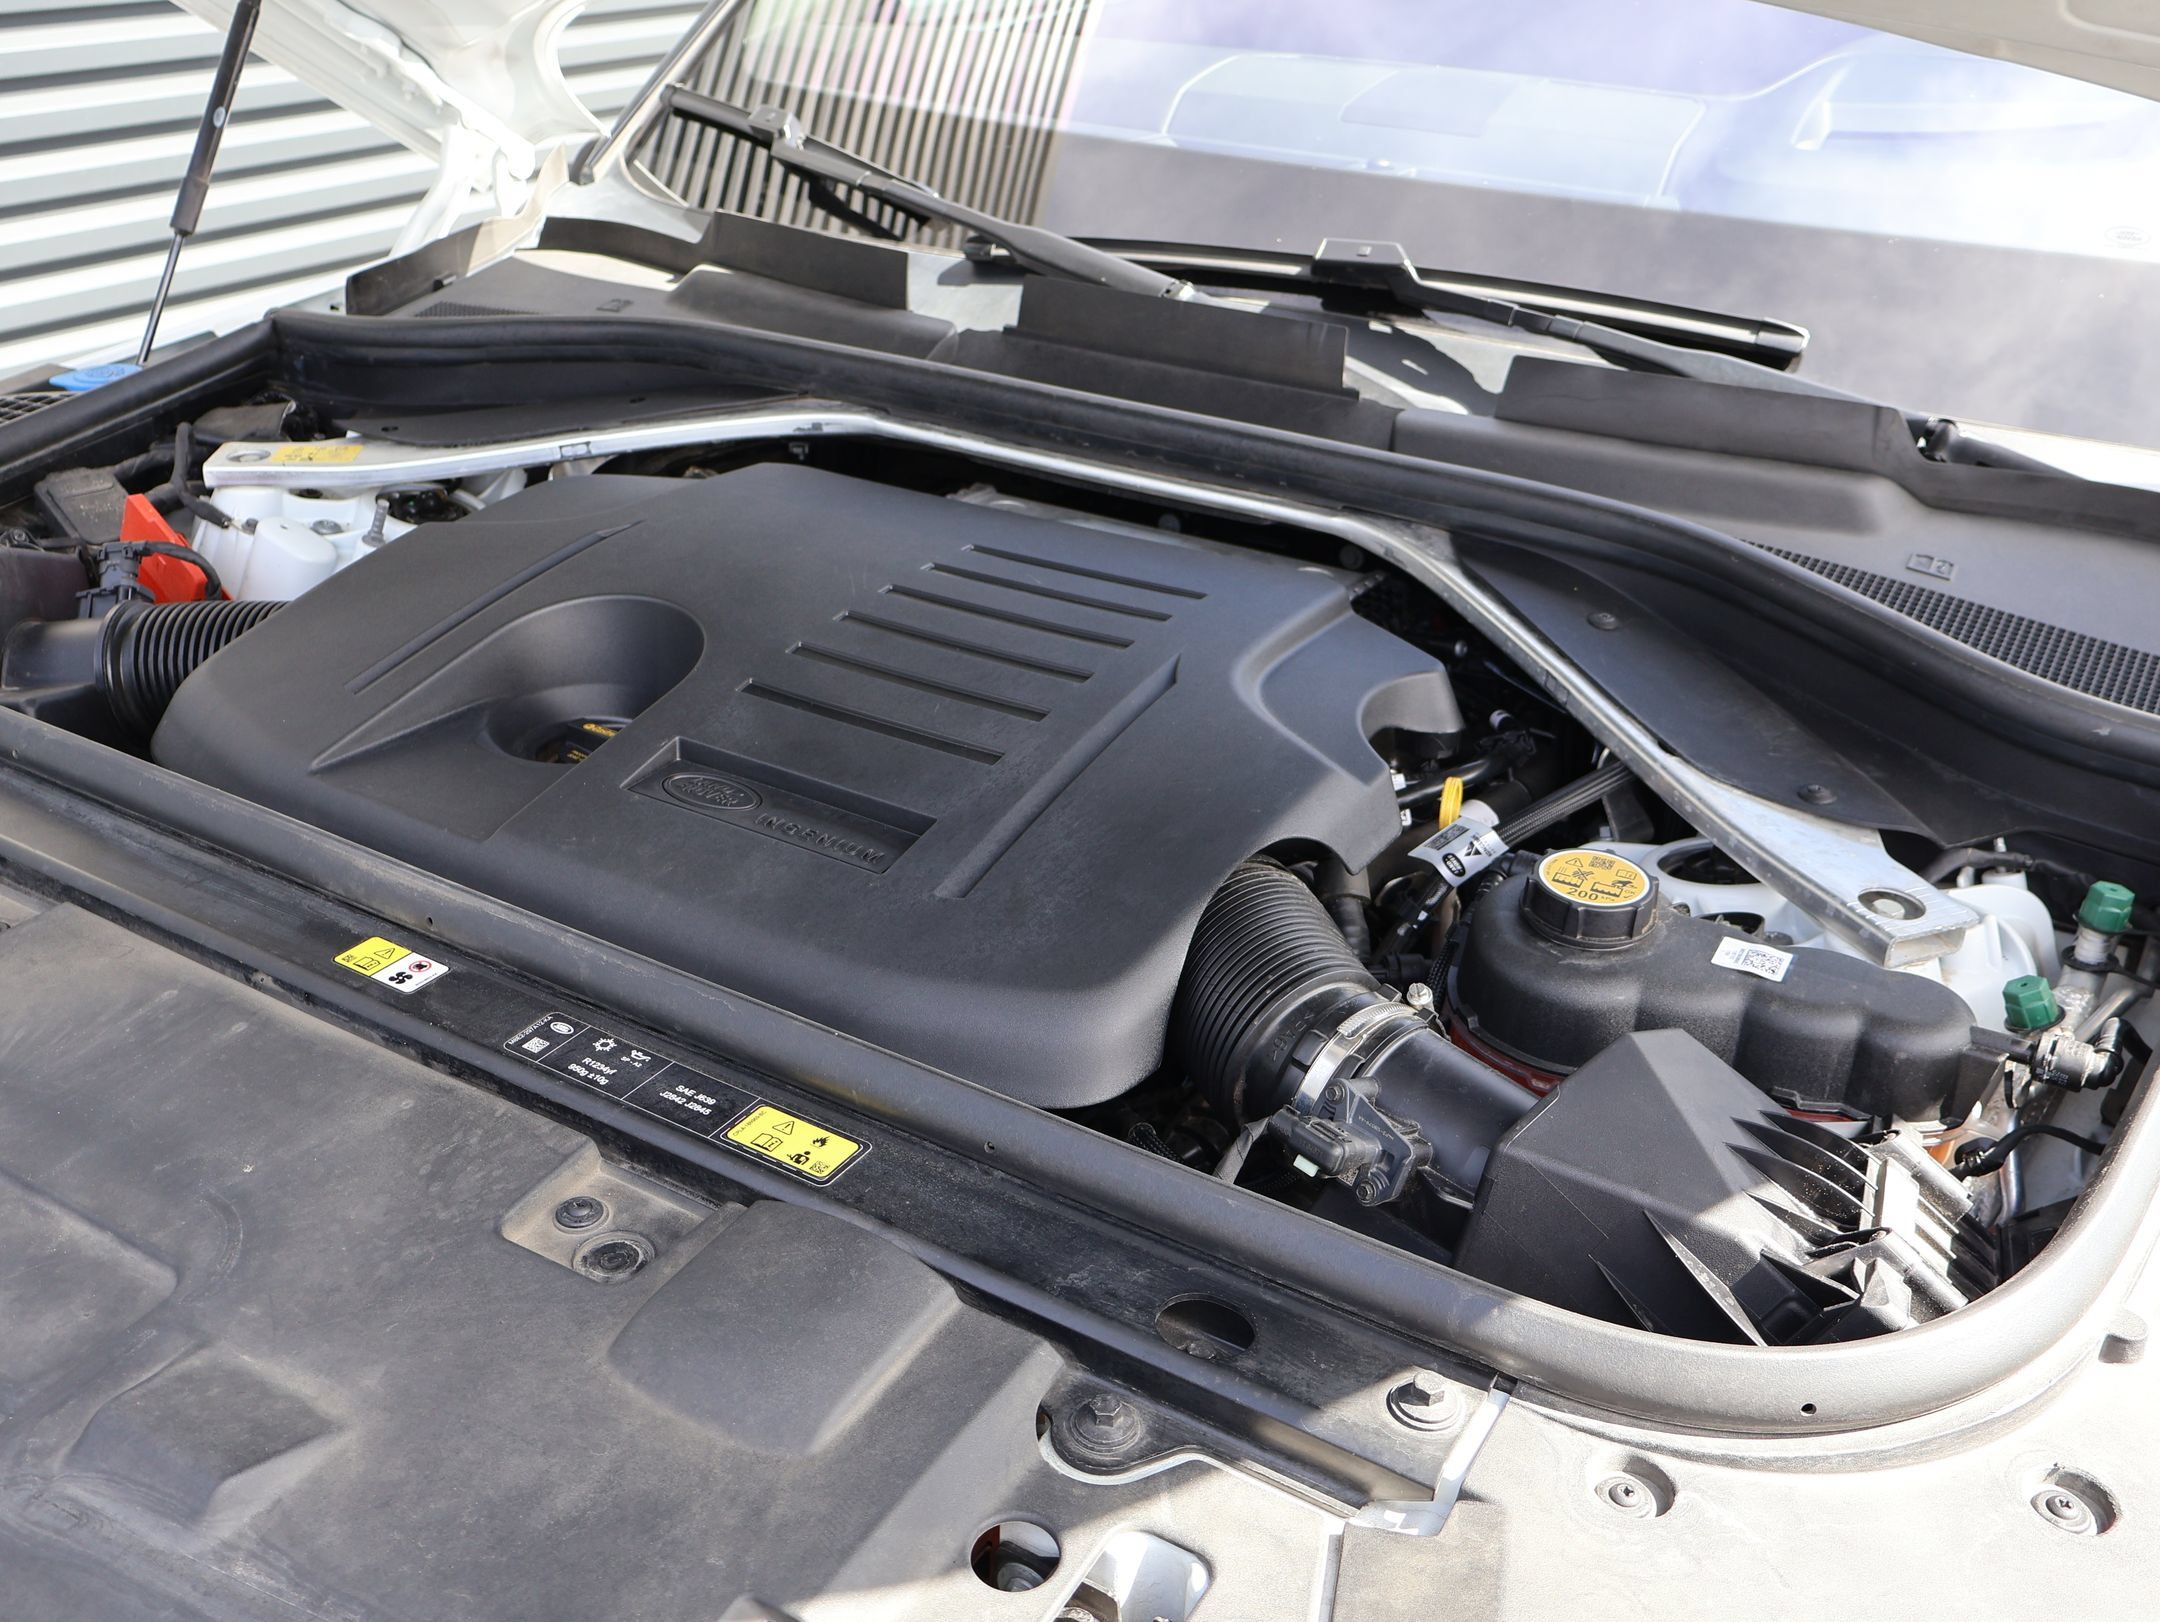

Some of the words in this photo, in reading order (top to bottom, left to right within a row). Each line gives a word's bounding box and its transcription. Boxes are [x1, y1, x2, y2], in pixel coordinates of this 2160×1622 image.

[754, 812, 885, 864] INGENIUM
[1567, 887, 1599, 901] 200
[567, 1063, 590, 1077] 950g
[586, 1072, 610, 1086] ±10g
[581, 1057, 618, 1075] R1234yf
[659, 1090, 687, 1105] J2842
[683, 1101, 713, 1116] J2845
[675, 1084, 697, 1097] SAE
[693, 1093, 717, 1106] J639
